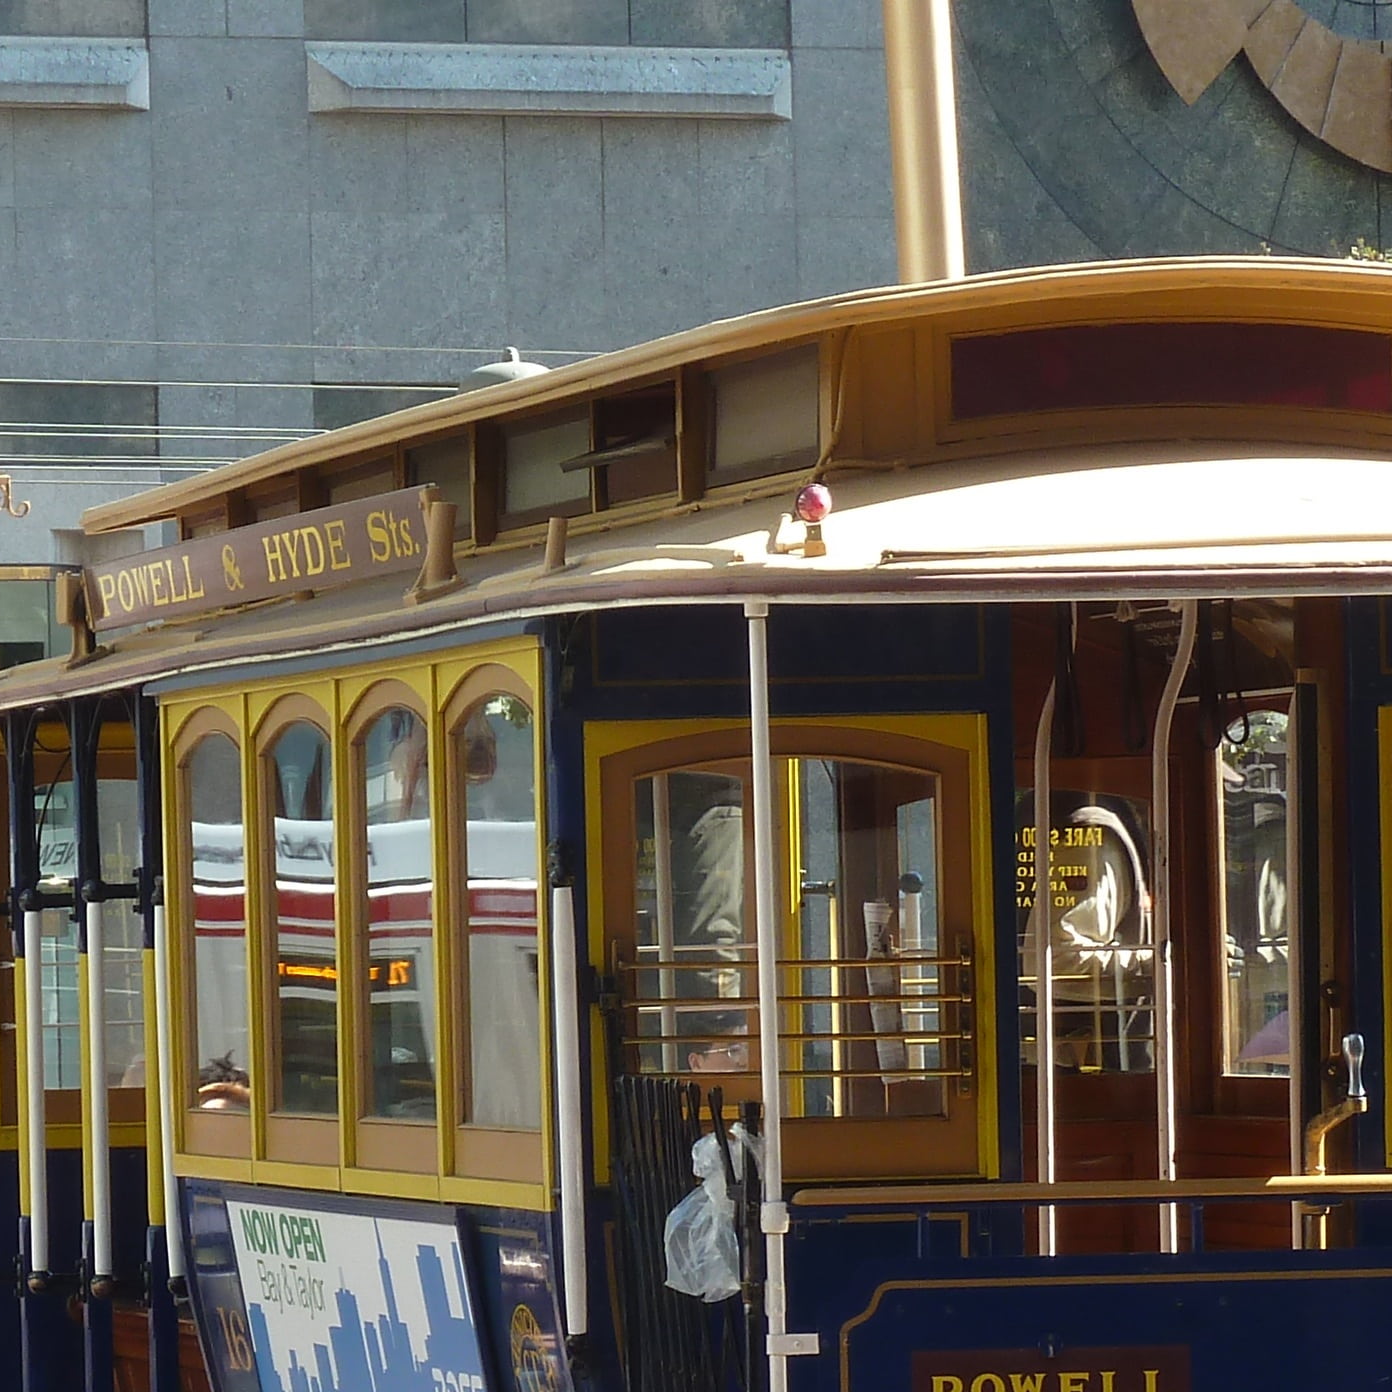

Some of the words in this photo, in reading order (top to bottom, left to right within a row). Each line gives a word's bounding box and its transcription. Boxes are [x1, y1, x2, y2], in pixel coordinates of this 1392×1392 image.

[98, 555, 204, 618] POWELL
[222, 544, 244, 591] &
[262, 519, 352, 583] HYDE
[367, 509, 420, 564] Sts.
[240, 1208, 279, 1256] NOW
[279, 1213, 326, 1263] OPEN
[257, 1259, 285, 1314] Bay
[288, 1264, 326, 1320] Taylor
[216, 1306, 252, 1372] 16
